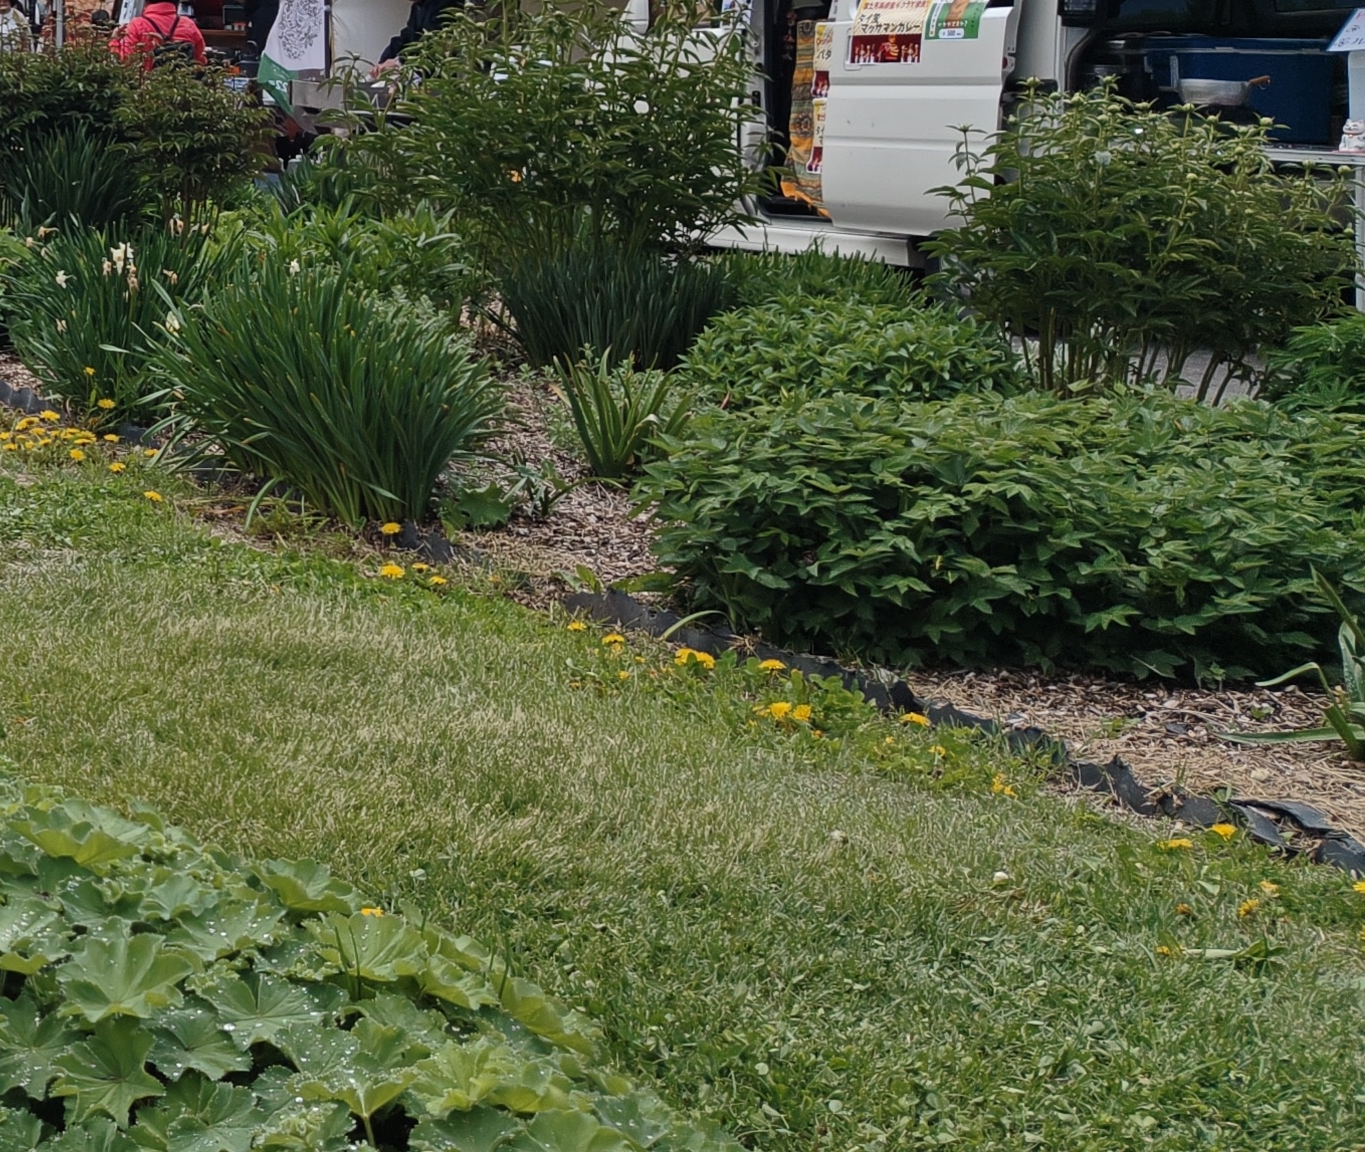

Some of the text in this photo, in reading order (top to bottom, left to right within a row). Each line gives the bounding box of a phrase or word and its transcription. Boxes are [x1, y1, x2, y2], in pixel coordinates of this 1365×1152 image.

[861, 22, 921, 34] マッサマンカレー
